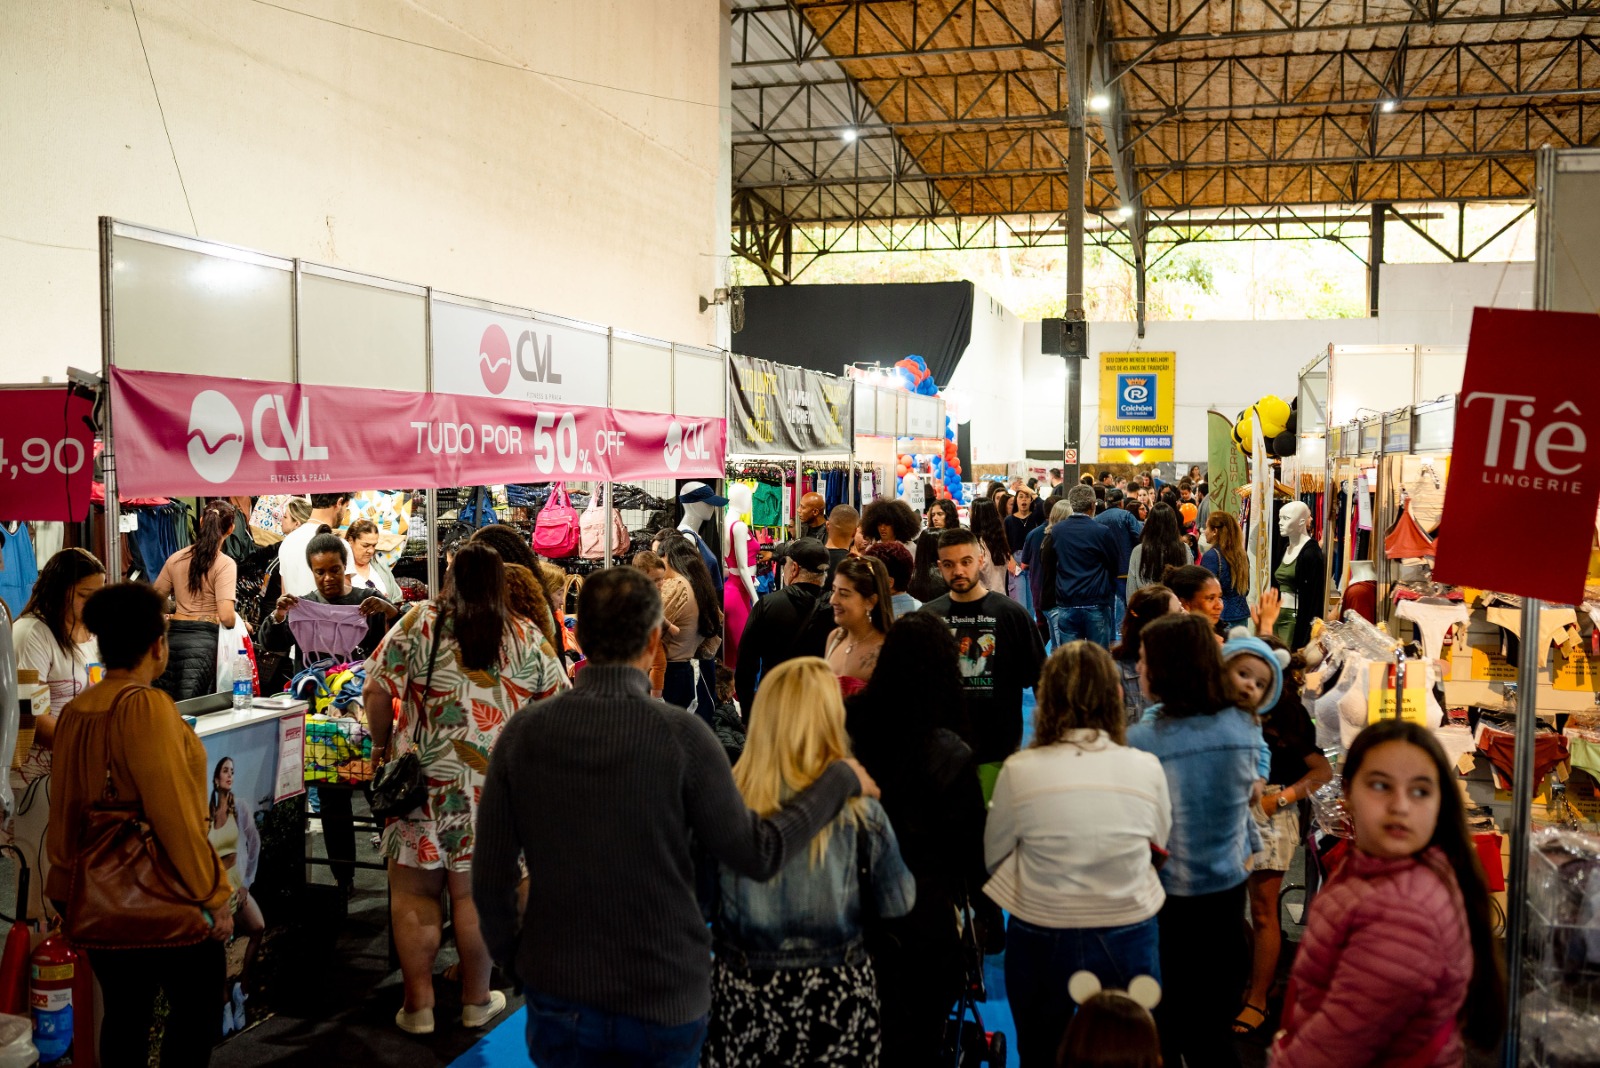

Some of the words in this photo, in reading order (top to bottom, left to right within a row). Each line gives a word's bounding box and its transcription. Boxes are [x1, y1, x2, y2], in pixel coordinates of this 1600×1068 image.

[516, 330, 562, 384] CVL
[1120, 404, 1153, 412] Colchões
[252, 394, 329, 461] CVL
[684, 422, 710, 460] CVL
[1104, 425, 1130, 433] GRANDES
[1463, 391, 1587, 475] Tiê
[410, 421, 474, 454] TUDO
[481, 425, 523, 455] POR
[533, 411, 593, 475] 50%
[595, 430, 626, 456] OFF
[270, 474, 300, 483] FITNESS
[309, 473, 331, 482] PRAIA
[1482, 471, 1583, 494] LINGERIE
[977, 614, 997, 623] News
